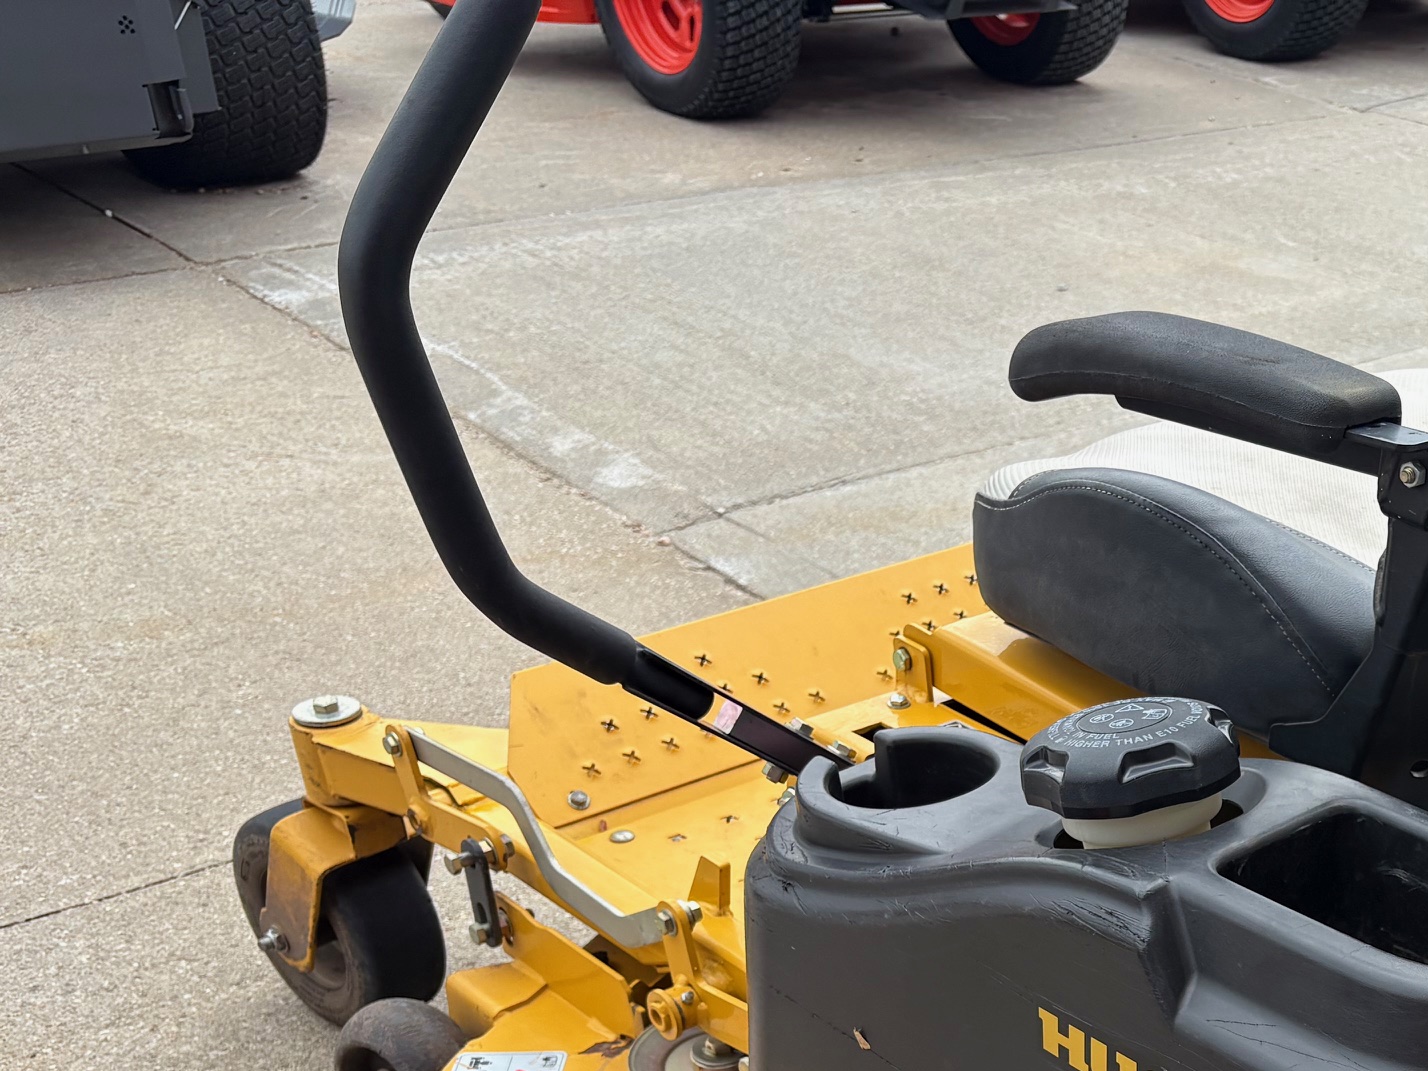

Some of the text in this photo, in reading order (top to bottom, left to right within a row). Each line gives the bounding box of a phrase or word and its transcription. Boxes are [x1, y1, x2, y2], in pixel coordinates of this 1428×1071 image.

[1063, 715, 1201, 748] HIGHER THAN E10 FUEL
